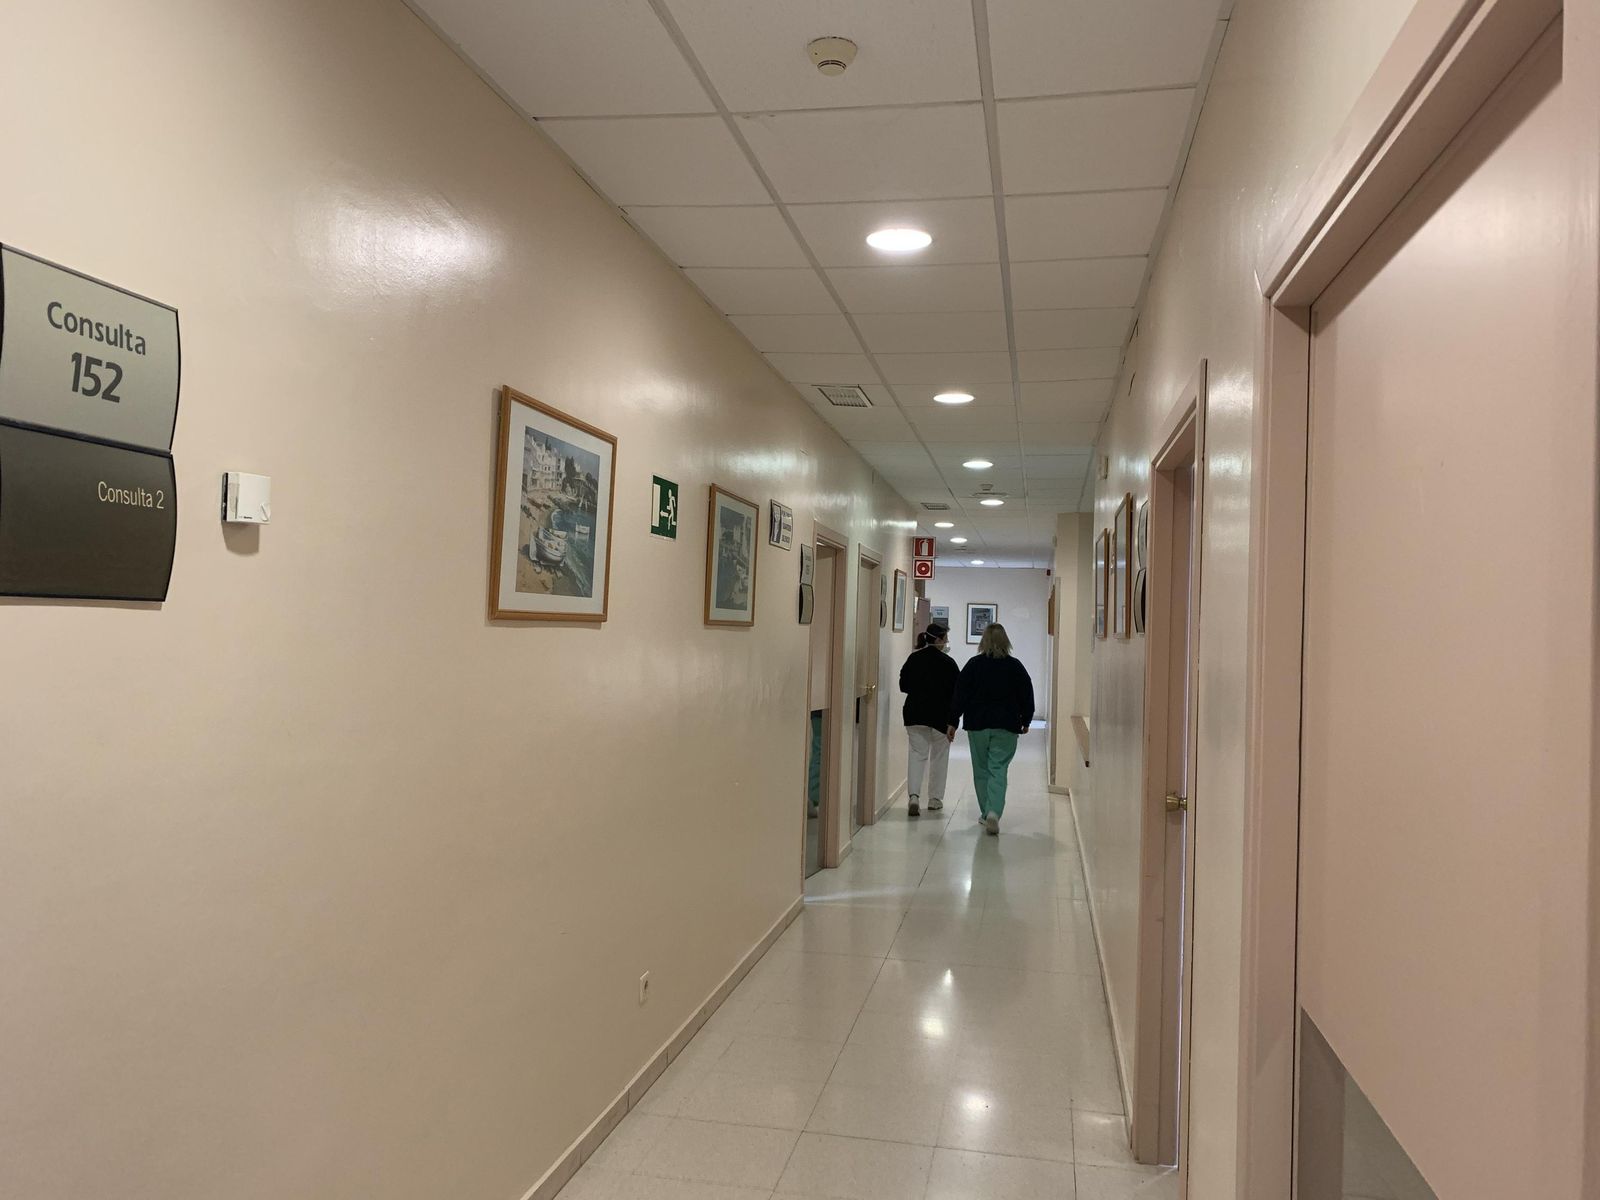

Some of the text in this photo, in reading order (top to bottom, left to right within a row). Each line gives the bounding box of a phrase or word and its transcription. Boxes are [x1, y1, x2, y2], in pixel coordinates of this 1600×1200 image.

[47, 301, 147, 356] Consulta
[71, 351, 124, 404] 152
[97, 480, 165, 509] Consulta 2
